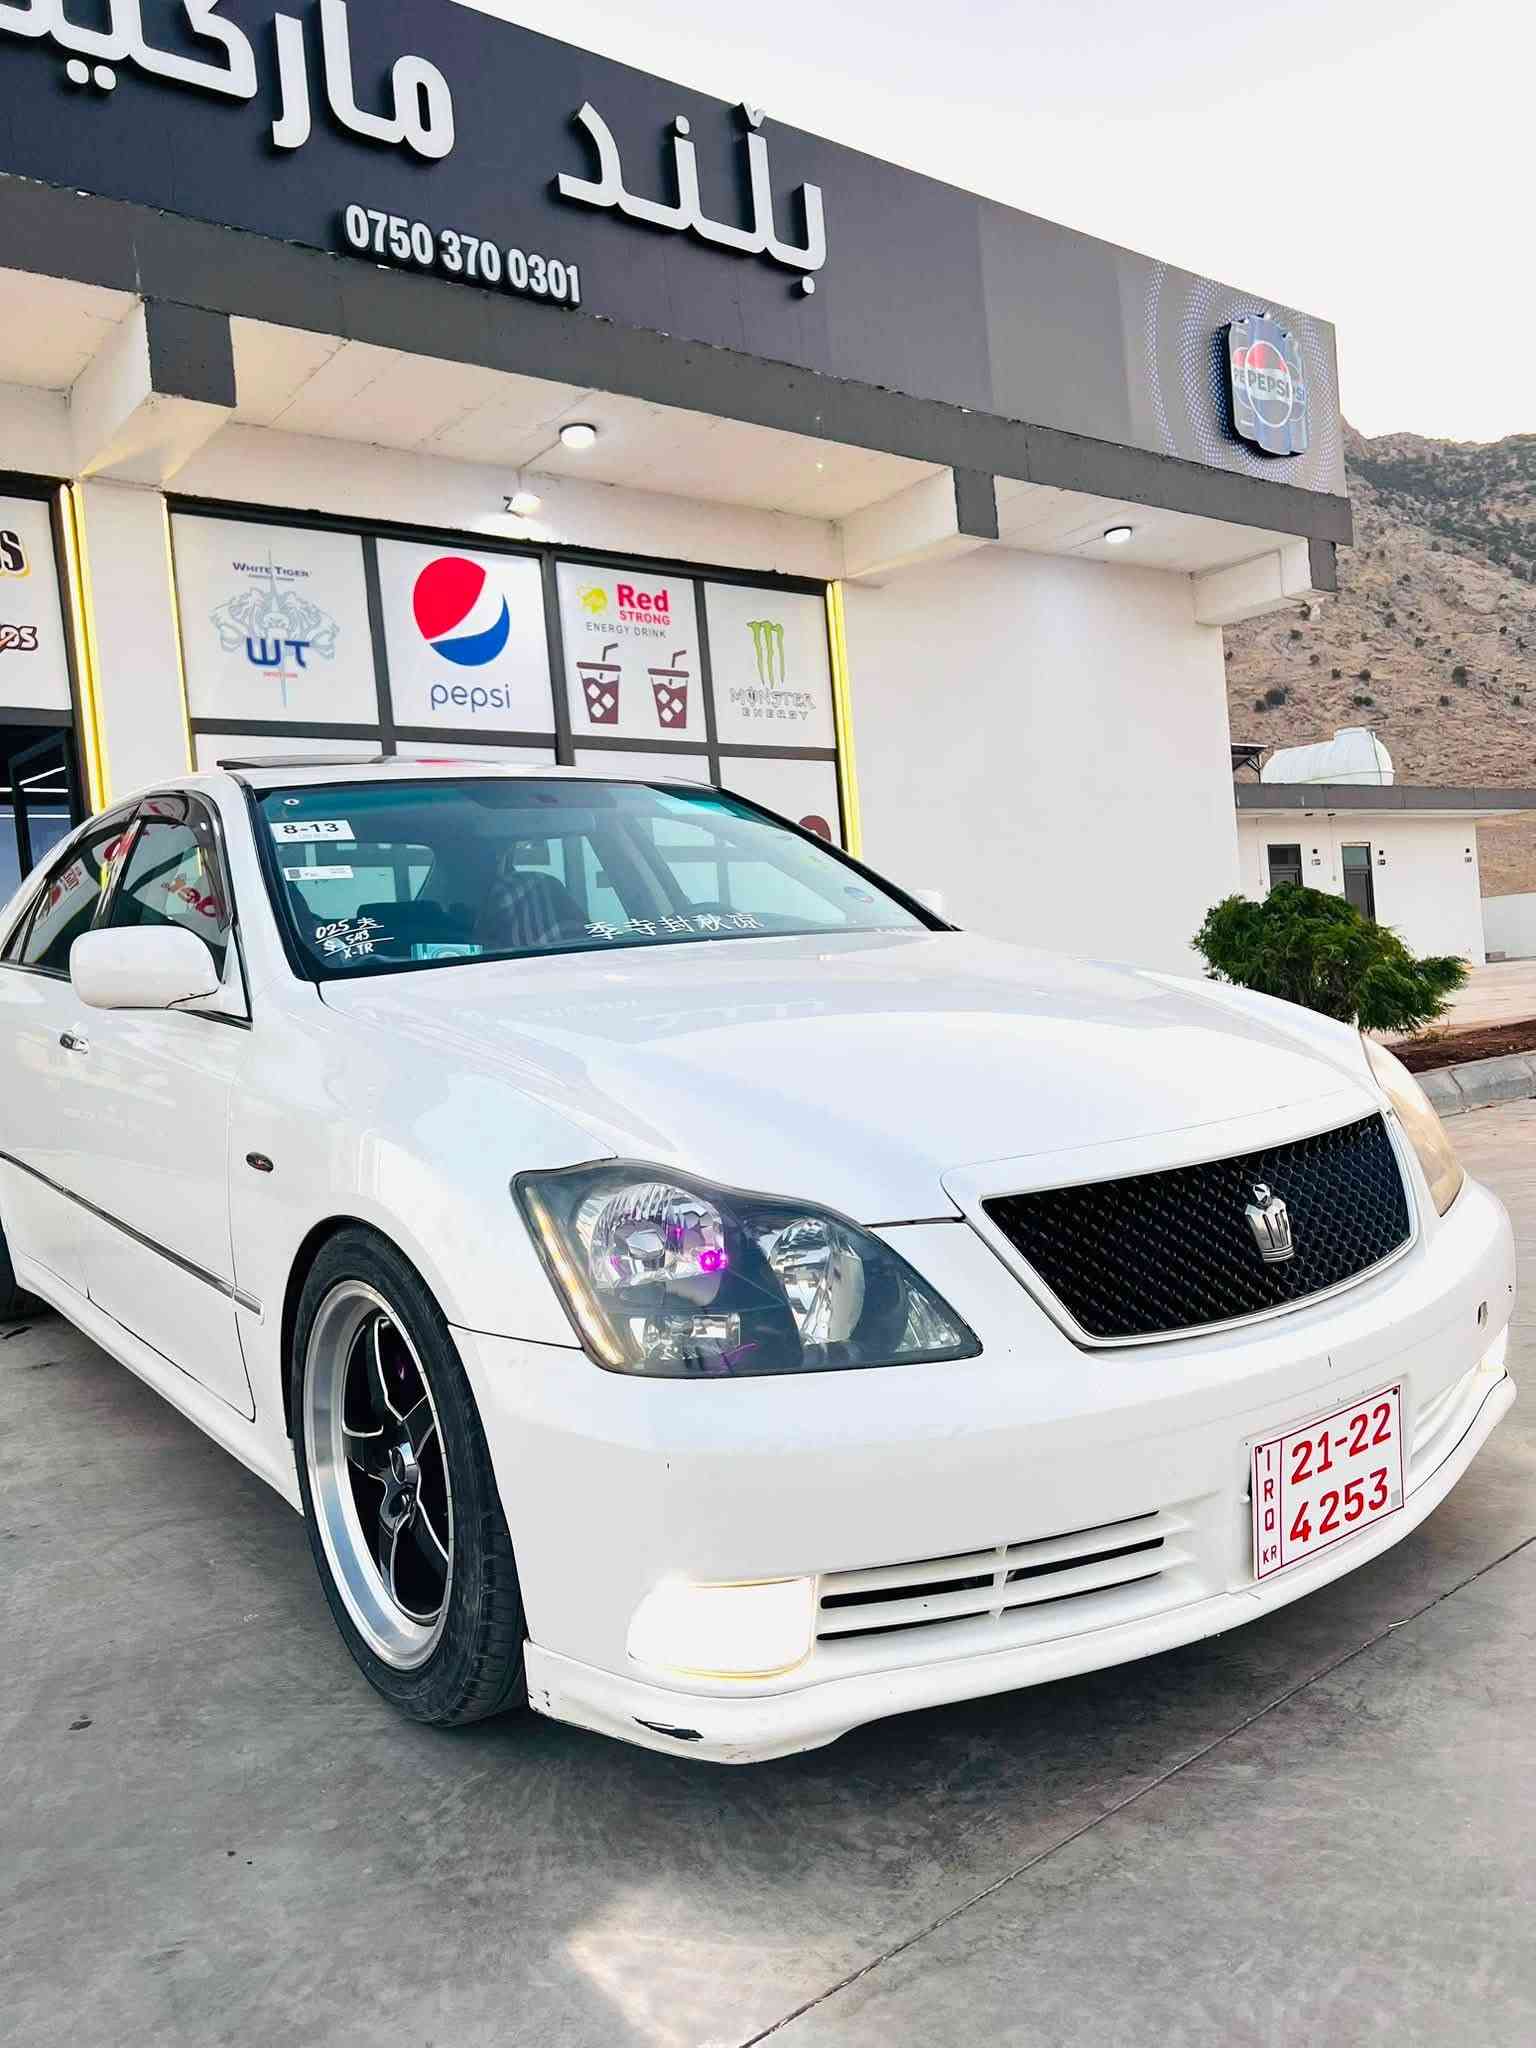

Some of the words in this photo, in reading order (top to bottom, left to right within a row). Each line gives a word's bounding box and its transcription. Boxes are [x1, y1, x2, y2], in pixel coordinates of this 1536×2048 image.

[346, 204, 434, 265] 0750
[441, 229, 501, 282] 370
[508, 248, 581, 303] 0301
[1247, 369, 1290, 399] PEPSI
[617, 583, 669, 612] Red
[586, 621, 630, 634] ENERGY
[634, 626, 667, 639] DRINK
[619, 610, 671, 625] STRONG
[430, 684, 511, 713] pepsi
[283, 823, 339, 834] 8-13
[1291, 1402, 1391, 1485] 21-22
[1263, 1450, 1275, 1532] IRQ
[1289, 1467, 1388, 1543] 4253
[1262, 1545, 1277, 1565] KR
